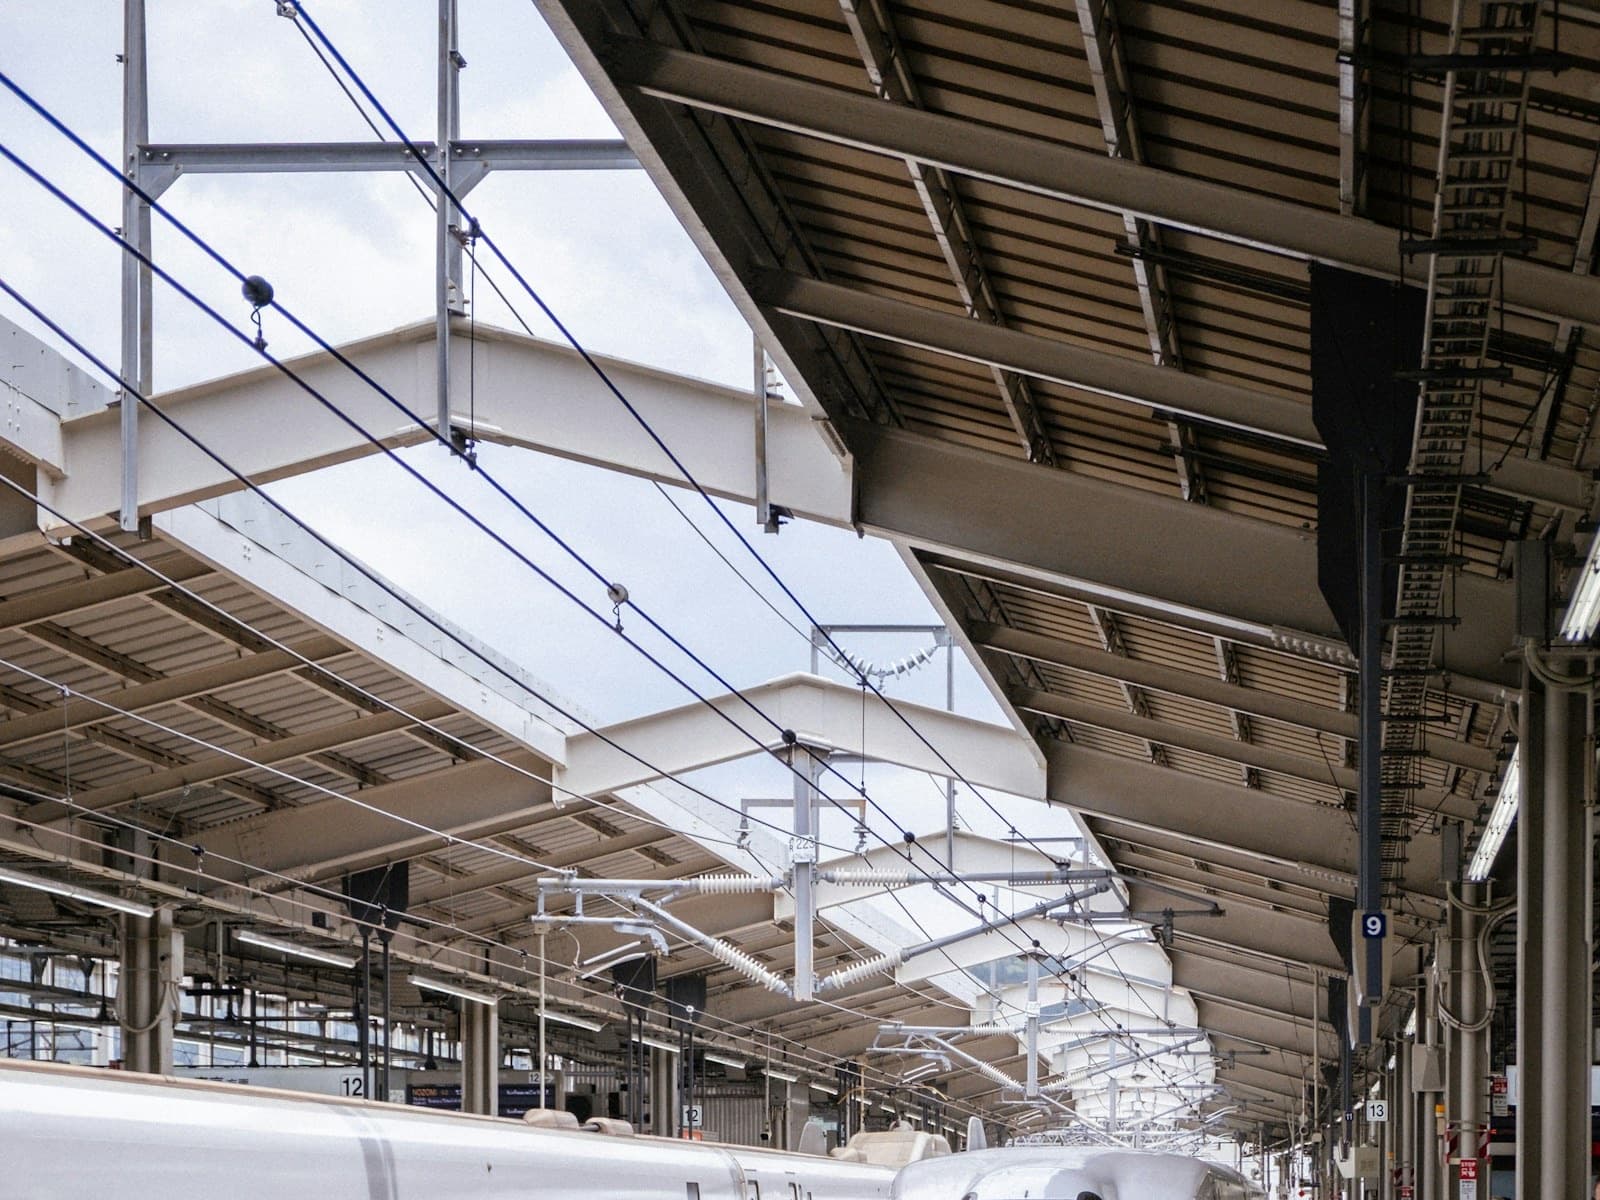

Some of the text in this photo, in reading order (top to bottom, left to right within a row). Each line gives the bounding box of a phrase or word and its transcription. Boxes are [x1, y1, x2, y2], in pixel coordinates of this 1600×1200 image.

[1367, 916, 1381, 935] 9
[530, 1074, 539, 1082] 12
[342, 1077, 363, 1096] 12
[685, 1109, 699, 1121] 12
[1370, 1104, 1384, 1117] 13
